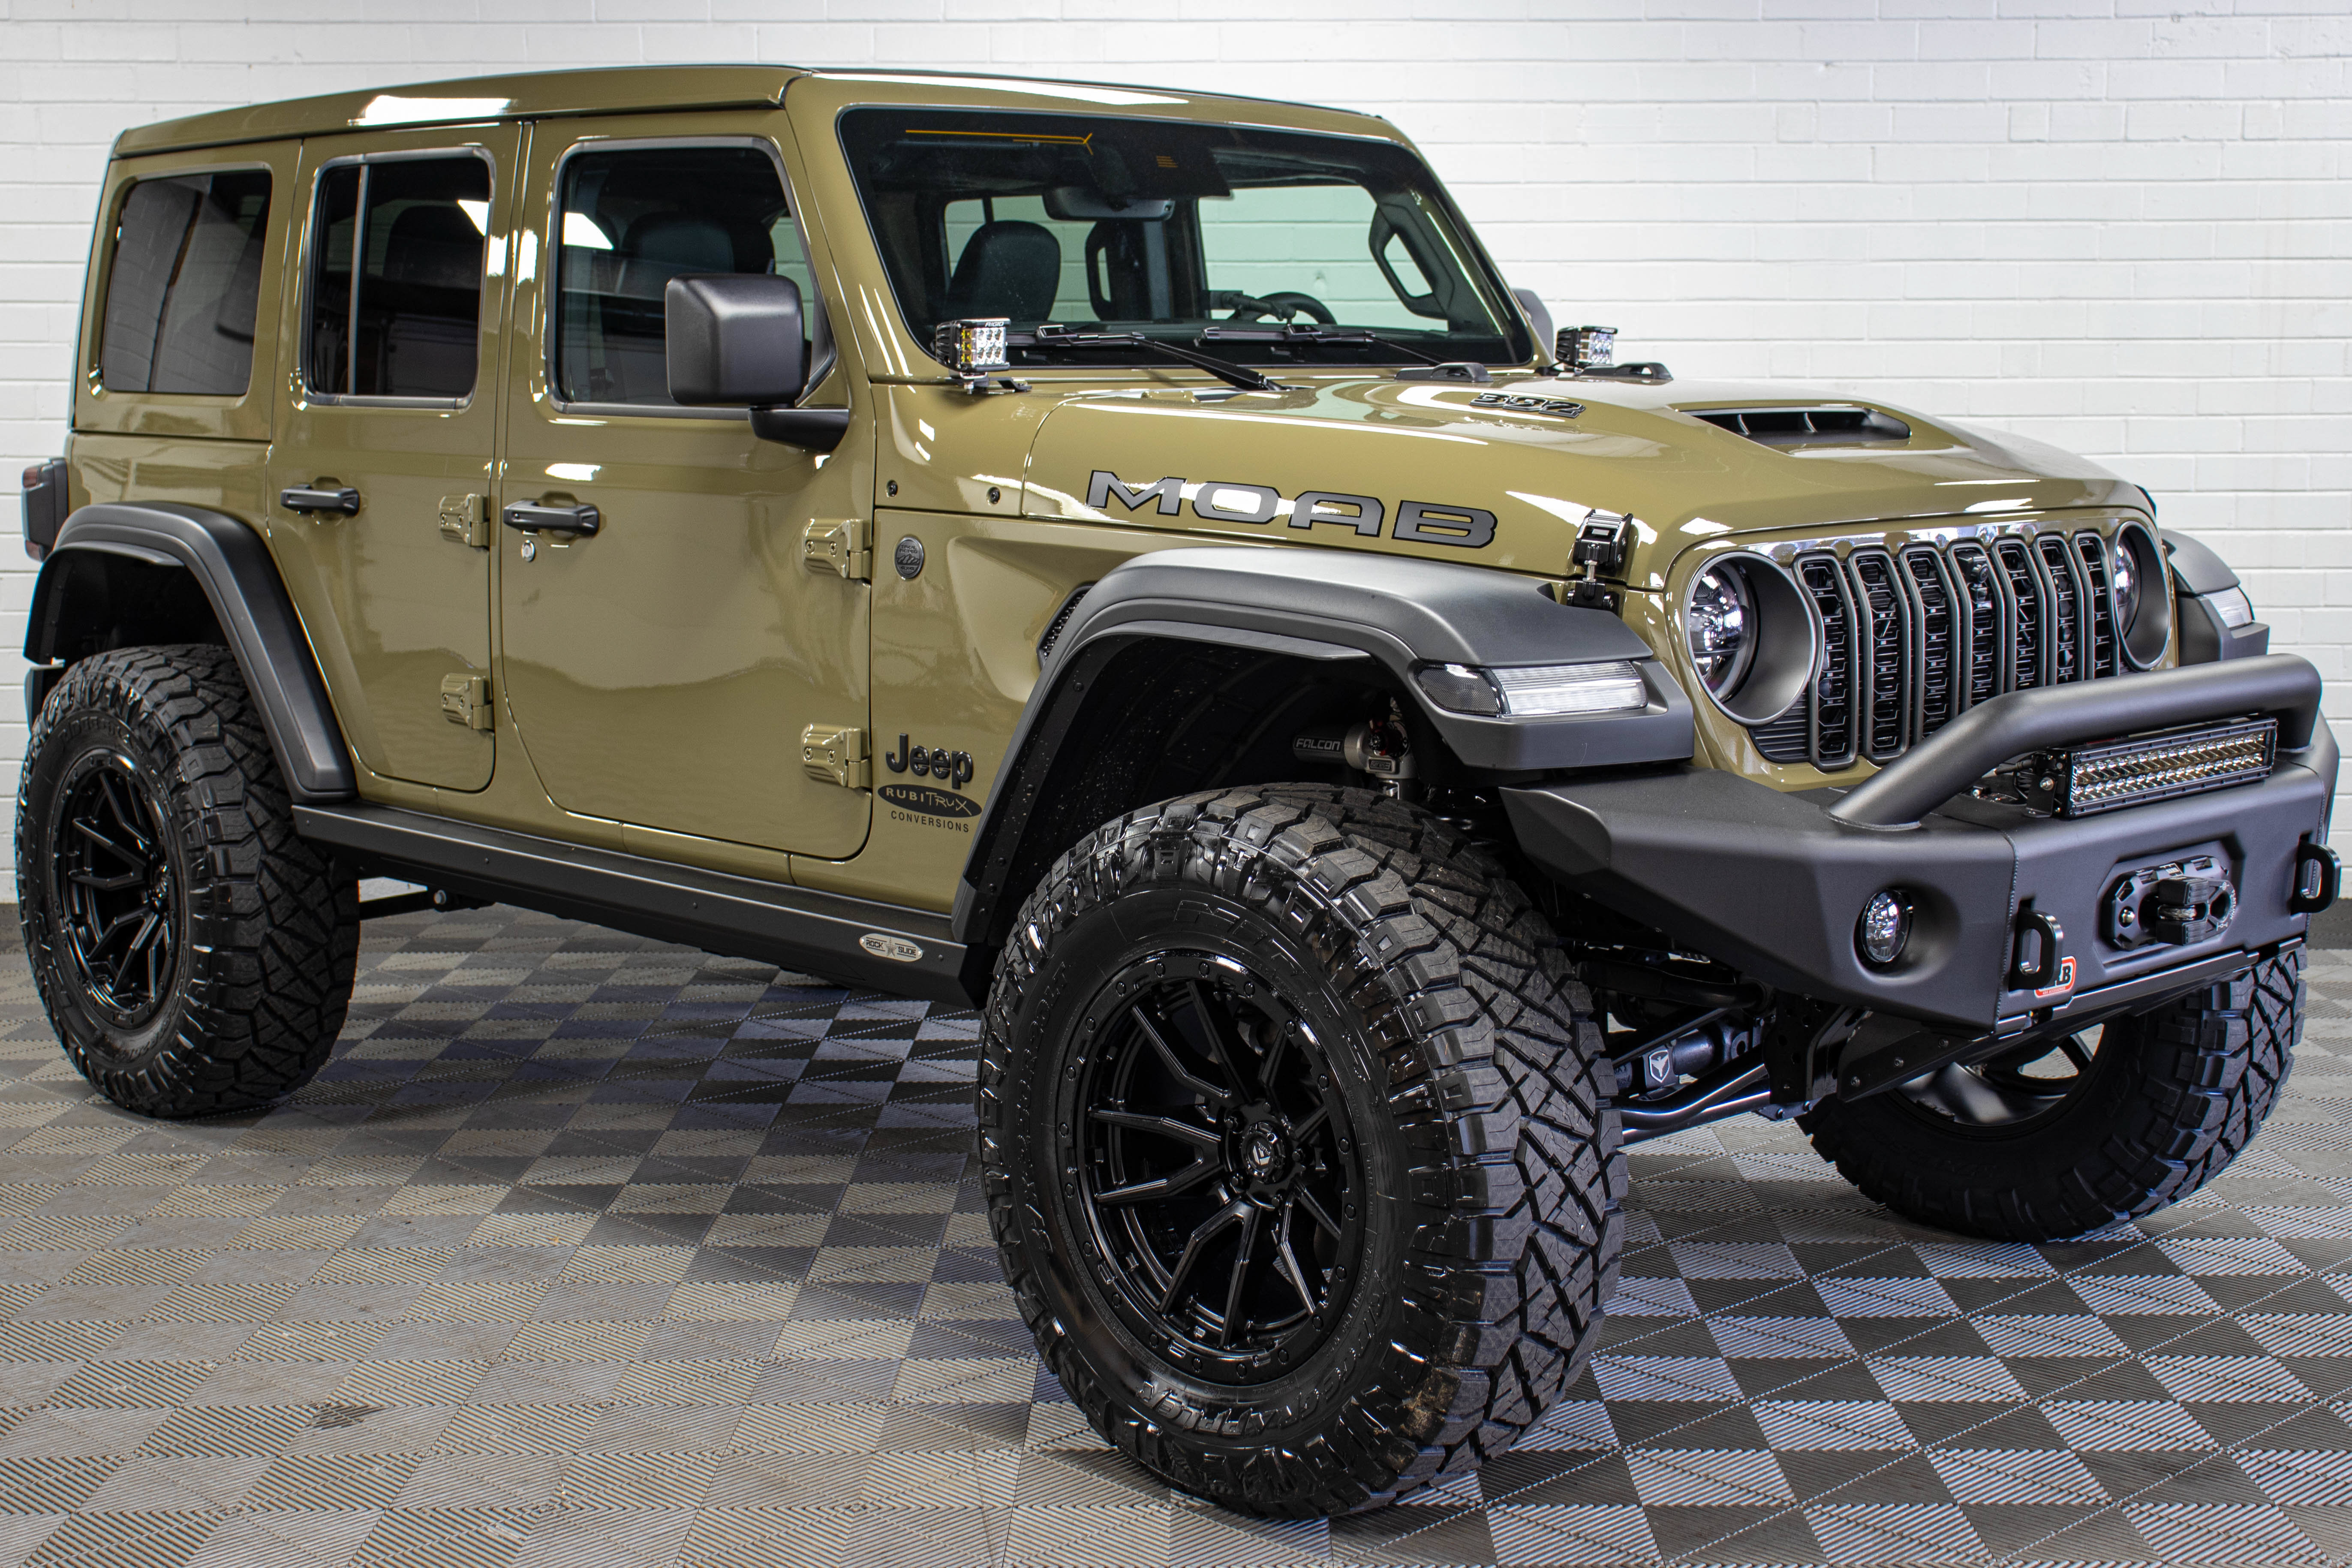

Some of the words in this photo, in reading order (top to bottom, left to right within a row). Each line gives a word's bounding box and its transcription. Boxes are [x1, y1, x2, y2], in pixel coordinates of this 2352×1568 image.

[1469, 392, 1586, 418] 392
[1085, 469, 1498, 549] MOAB
[1296, 738, 1341, 750] FALCON
[886, 733, 973, 790] Jeep
[891, 810, 969, 833] CONVERSIONS
[866, 939, 884, 949] ROCK
[898, 947, 916, 956] SLIDE
[1133, 1369, 1327, 1442] GRAPPLER
